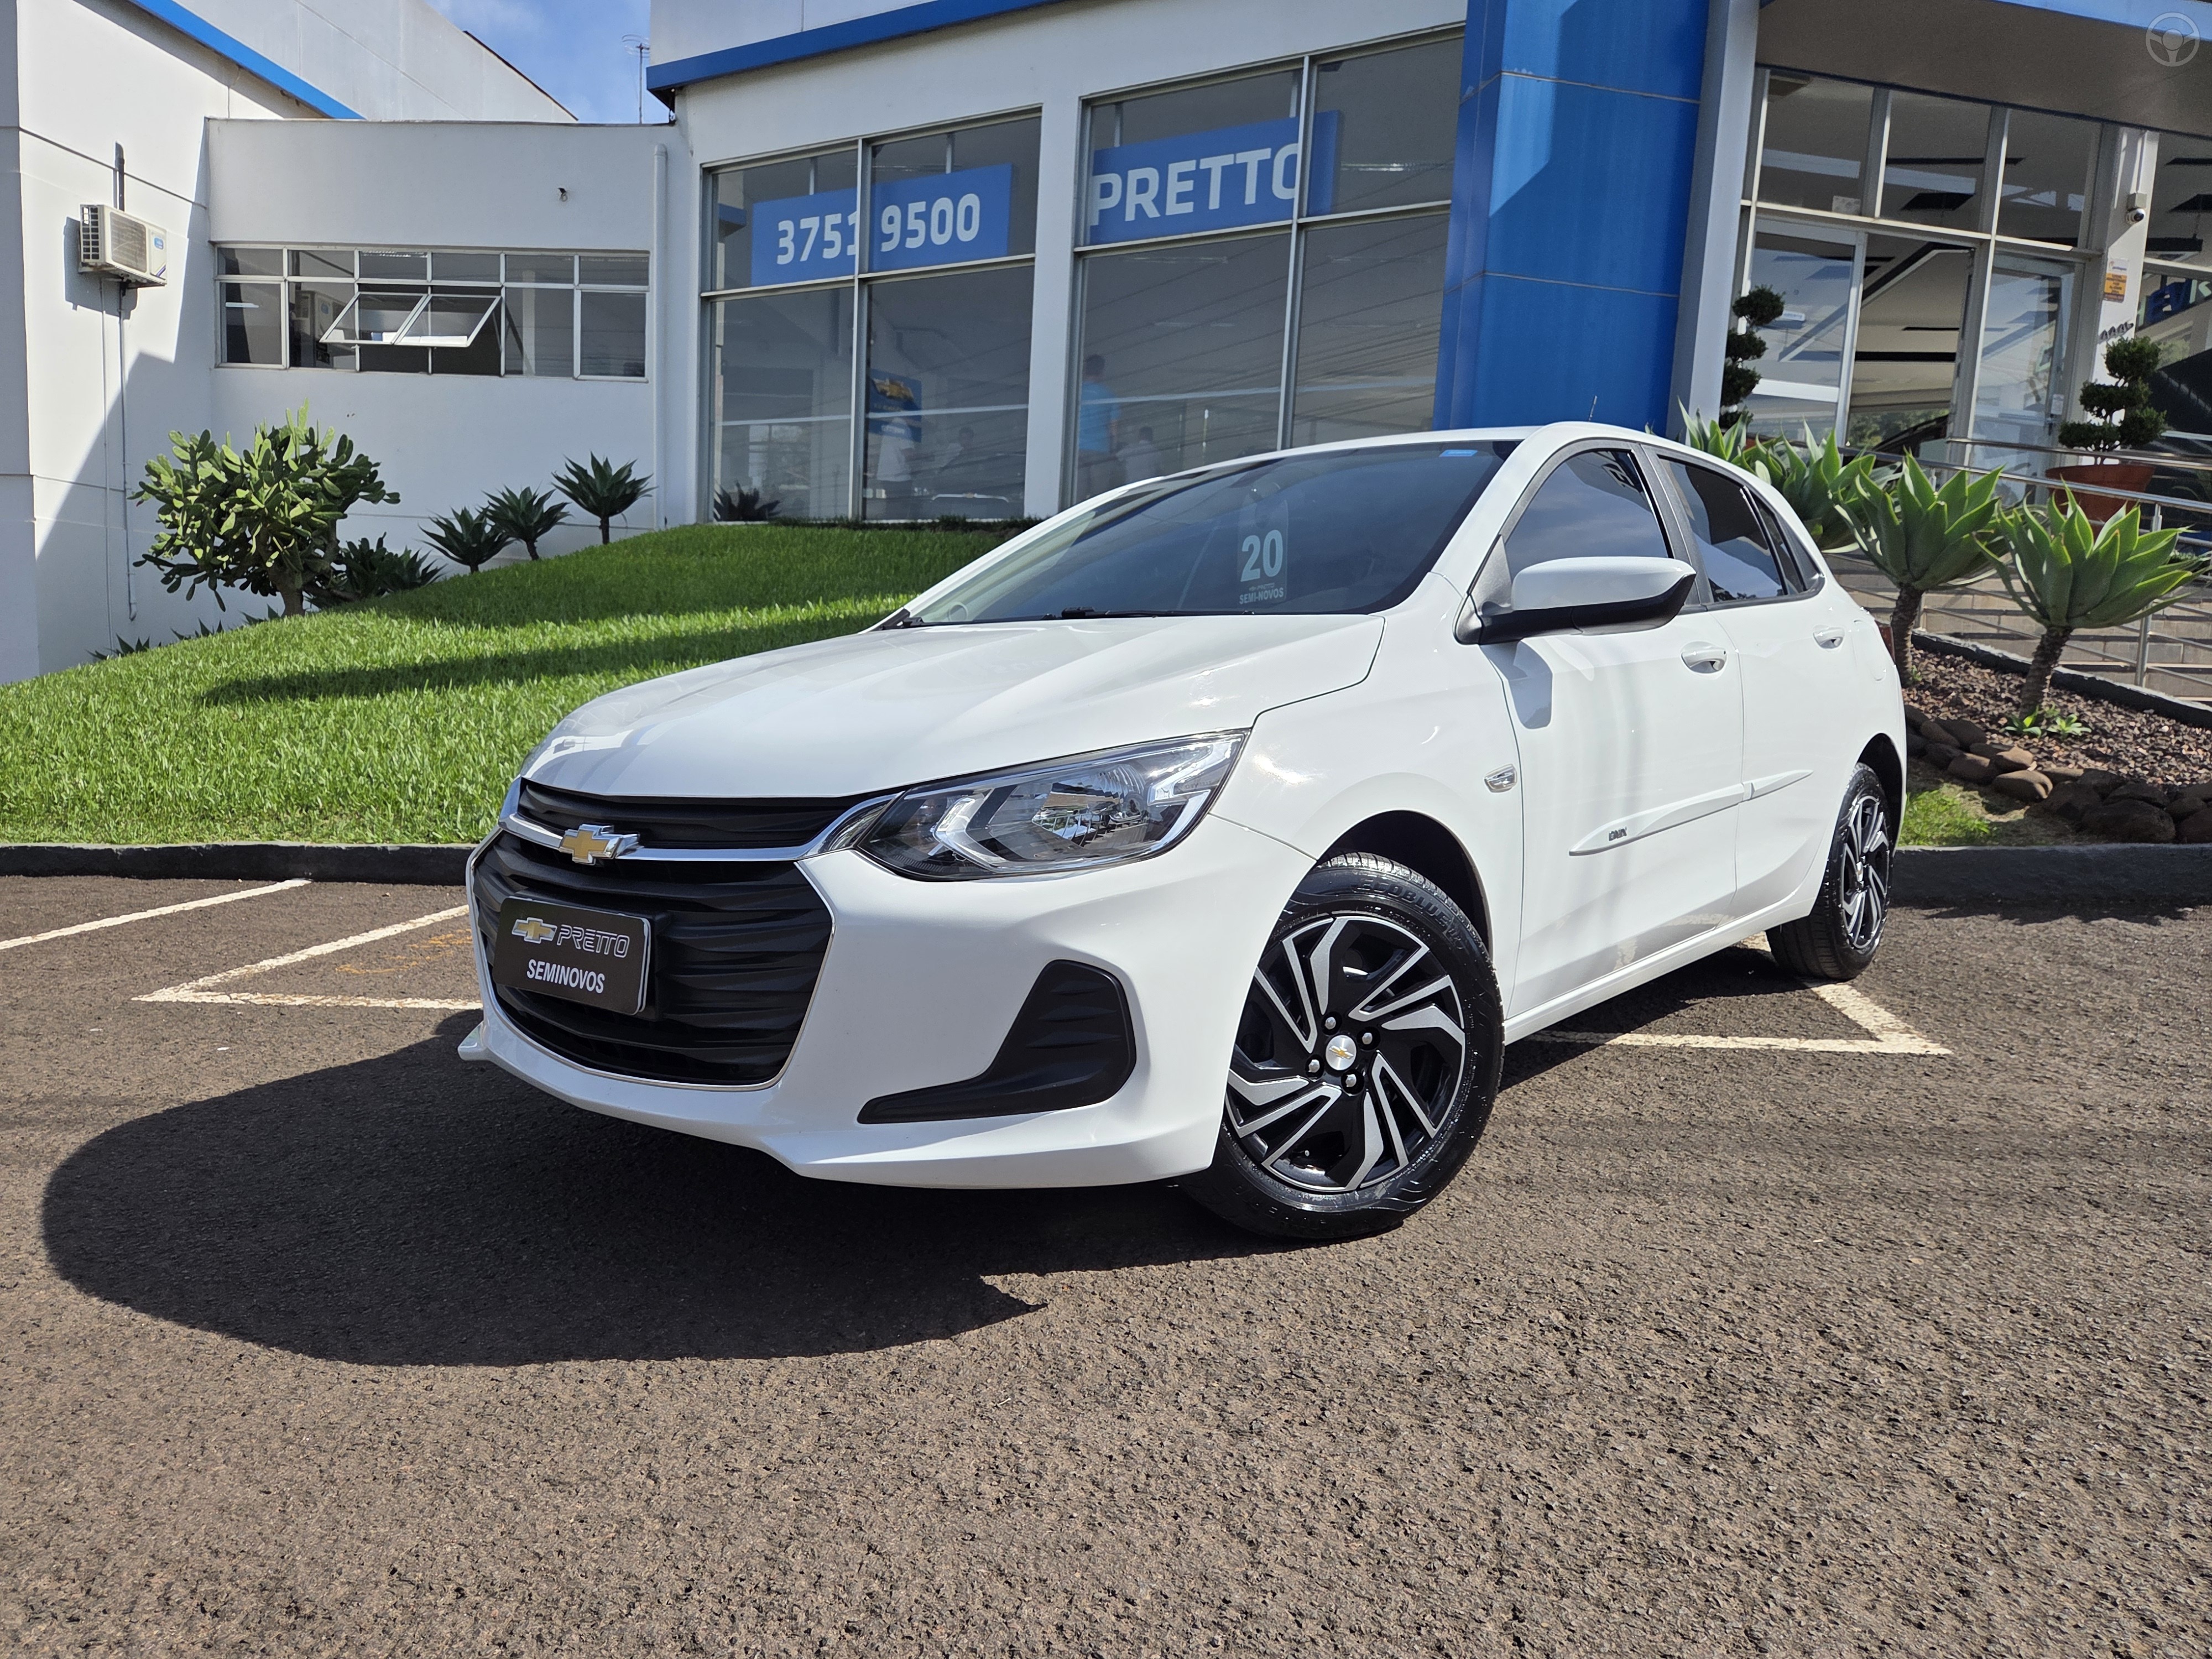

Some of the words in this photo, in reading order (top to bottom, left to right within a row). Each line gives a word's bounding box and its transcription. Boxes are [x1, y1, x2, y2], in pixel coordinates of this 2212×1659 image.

[1089, 143, 1299, 226] PRETTO
[880, 194, 980, 252] 9500
[1240, 530, 1283, 582] 20
[1239, 587, 1284, 604] SEMI-NOVOS
[1357, 879, 1452, 927] ECOBLUE
[557, 924, 630, 958] PRETTO
[527, 959, 605, 993] SEMINOVOS
